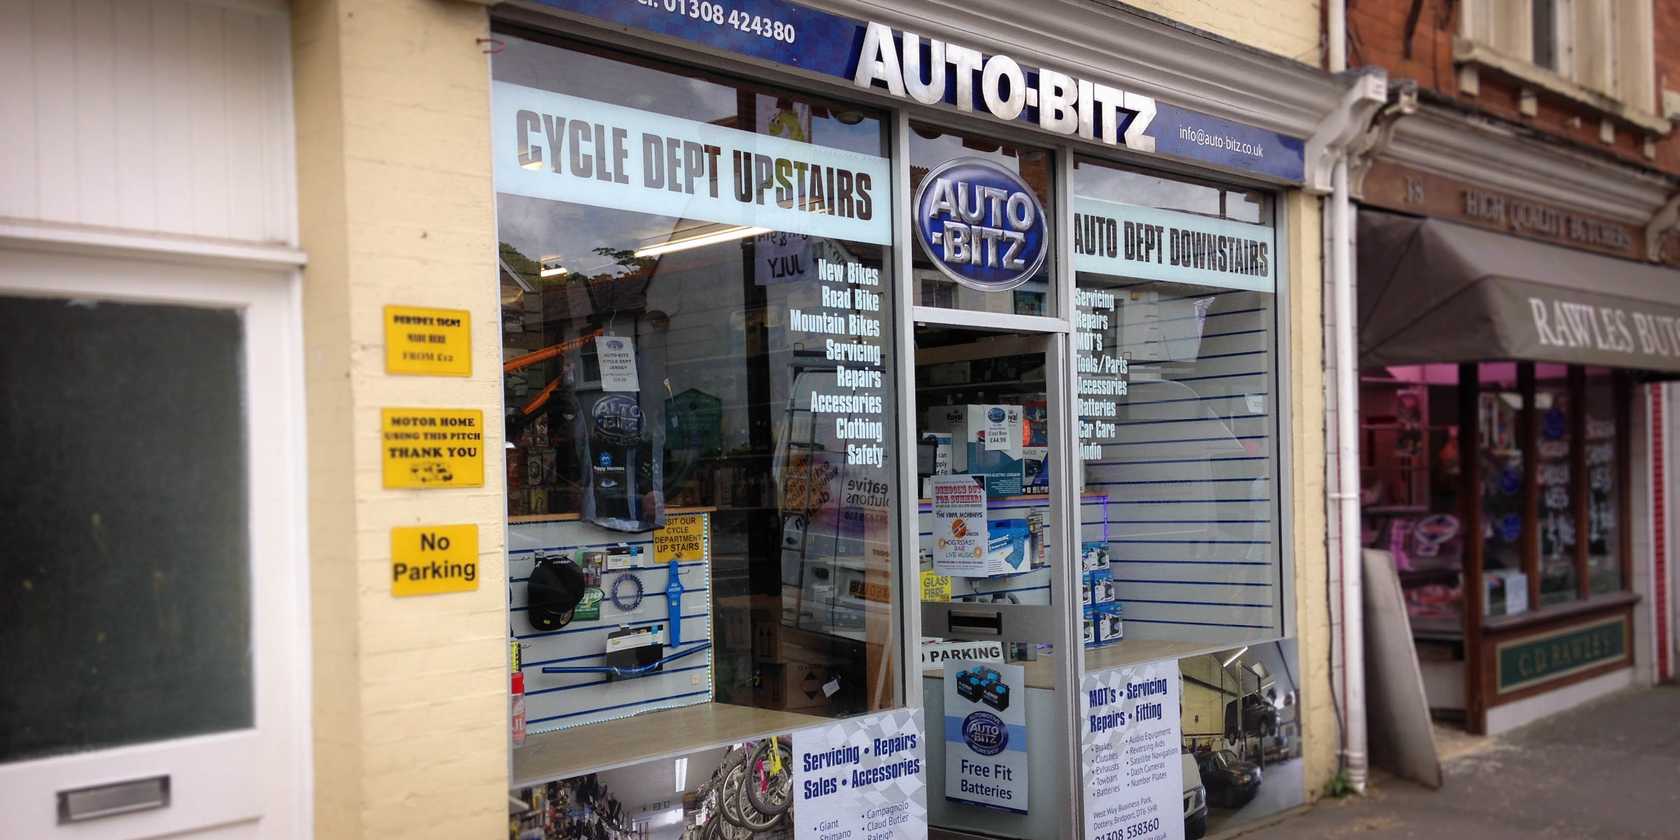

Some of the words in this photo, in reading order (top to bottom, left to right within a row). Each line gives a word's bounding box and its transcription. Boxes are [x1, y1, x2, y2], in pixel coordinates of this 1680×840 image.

[728, 10, 795, 43] 424380
[854, 21, 1157, 153] AUTO-BITZ
[1178, 125, 1264, 158] info@auto-bitz.co.uk
[516, 109, 629, 185] CYCLE
[641, 132, 721, 199] DEPT
[732, 149, 872, 221] UPSTAIRS
[929, 178, 1033, 231] AUTO
[1465, 189, 1505, 222] HIGH
[1510, 201, 1566, 233] QUALITY
[1074, 213, 1117, 258] AUTO
[1123, 220, 1164, 265] DEPT
[1170, 228, 1269, 278] DOWNSTAIRS
[818, 259, 843, 282] New
[847, 261, 879, 286] Bikes
[822, 285, 850, 308] Road
[855, 288, 879, 311] Bike
[1076, 288, 1114, 311] Servicing
[790, 309, 845, 335] Mountain
[849, 314, 880, 336] Bikes
[1076, 310, 1108, 330] Repairs
[1528, 297, 1634, 354] RAWLES
[1632, 311, 1680, 356] BUT
[402, 351, 434, 361] FROM
[826, 339, 880, 366] Servicing
[1077, 354, 1128, 376] Tools/Parts
[836, 366, 881, 390] Repairs
[1077, 376, 1128, 395] Accessories
[810, 391, 882, 414] Accessories
[1078, 398, 1116, 417] Batteries
[391, 417, 436, 427] MOTOR
[440, 417, 475, 427] HOME
[836, 418, 882, 442] Clothing
[1079, 420, 1094, 438] Car
[1096, 421, 1115, 438] Care
[383, 432, 420, 440] USING
[423, 432, 448, 440] THIS
[450, 432, 481, 440] PITCH
[389, 447, 442, 458] THANK
[447, 447, 477, 458] YOU
[847, 444, 883, 468] Safety
[1079, 442, 1102, 460] Audio
[666, 526, 689, 534] CYCLE
[680, 516, 696, 526] OUR
[421, 532, 450, 551] No
[655, 534, 703, 544] DEPARTMENT
[656, 544, 669, 553] UP
[670, 542, 700, 552] STAIRS
[392, 560, 476, 582] Parking
[930, 646, 1001, 663] PARKING
[1089, 687, 1116, 709] MOT's
[1127, 677, 1168, 701] Servicing
[1090, 711, 1125, 733] Repairs
[1136, 702, 1162, 722] Fitting
[970, 724, 999, 736] AUTO
[803, 745, 860, 772] Servicing
[874, 733, 917, 757] Repairs
[804, 777, 837, 800] Sales
[852, 758, 920, 788] Accessories
[961, 759, 990, 778] Free
[995, 764, 1012, 781] Fit
[1096, 763, 1119, 775] Exhausts
[1130, 766, 1143, 777] Dash
[1144, 761, 1165, 773] Cameras
[961, 779, 1012, 800] Batteries
[1096, 786, 1120, 797] Batteries
[1131, 775, 1151, 787] Number
[867, 801, 909, 819] Campagnolo
[820, 819, 839, 832] Giant
[867, 820, 887, 833] Claud
[888, 813, 909, 827] Butler
[1127, 817, 1160, 840] 538360
